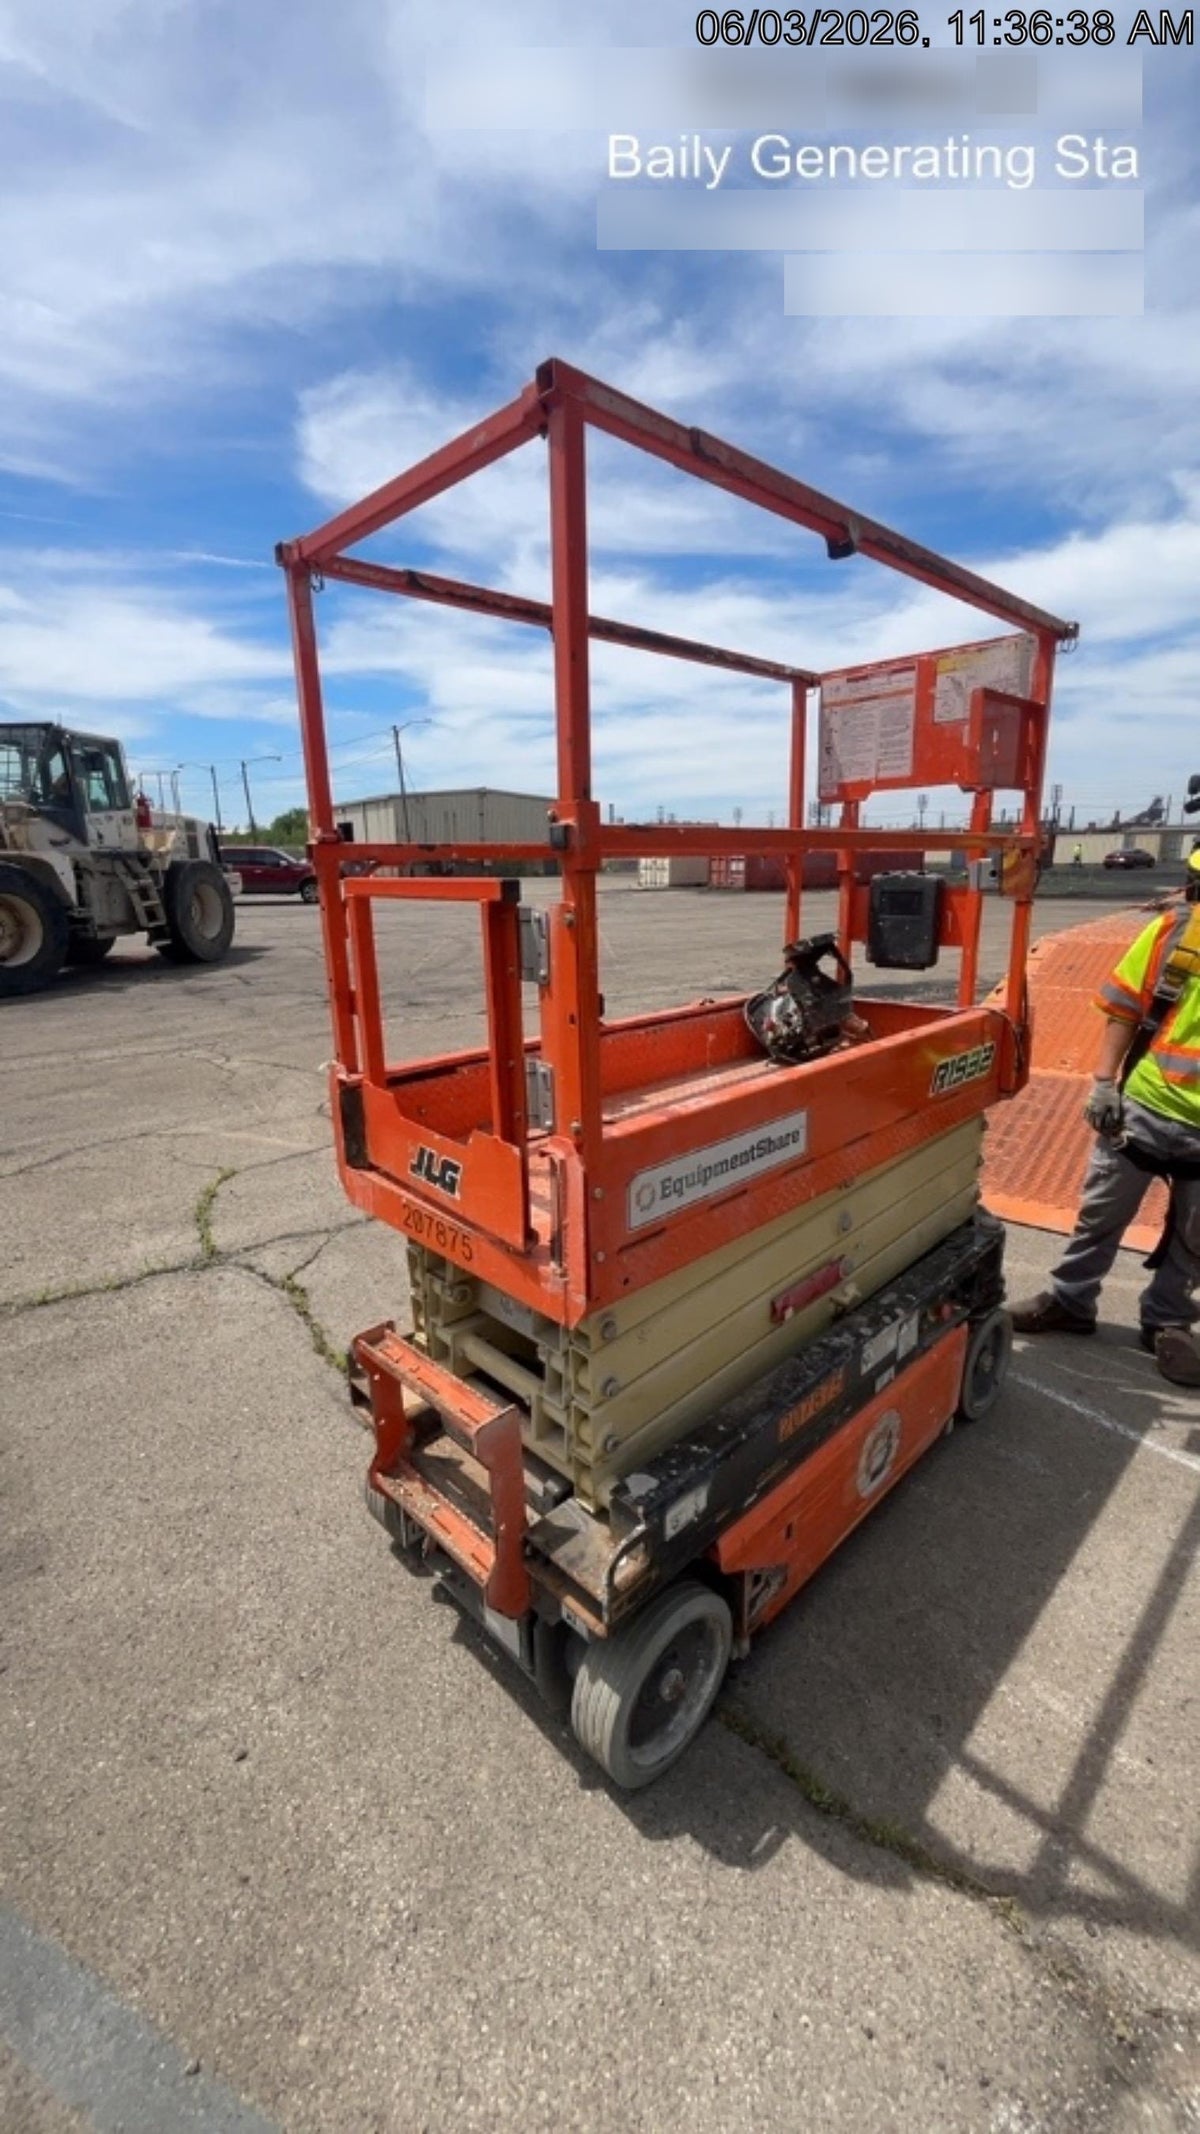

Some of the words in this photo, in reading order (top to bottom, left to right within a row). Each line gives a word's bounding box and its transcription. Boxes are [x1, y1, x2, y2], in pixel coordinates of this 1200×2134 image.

[409, 1146, 461, 1197] JLG
[659, 1127, 800, 1200] EquipmentShare
[402, 1203, 473, 1262] 207875
